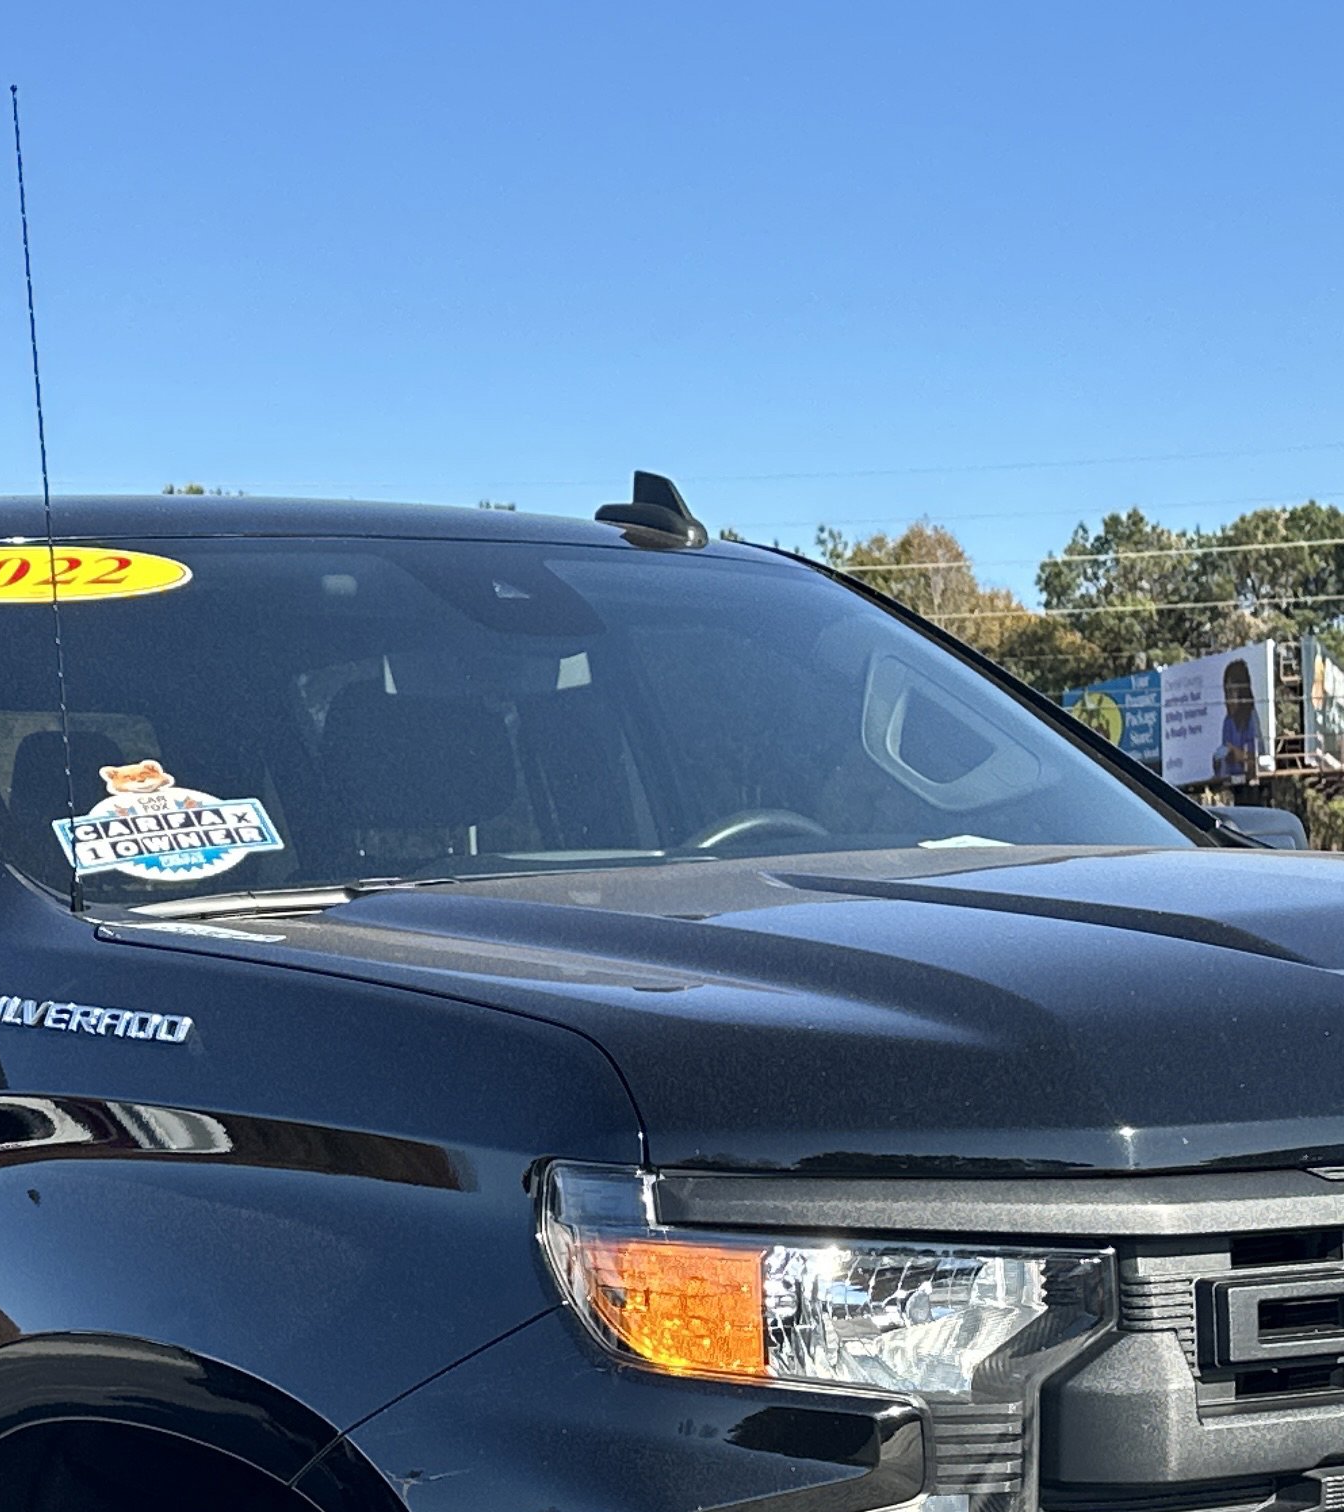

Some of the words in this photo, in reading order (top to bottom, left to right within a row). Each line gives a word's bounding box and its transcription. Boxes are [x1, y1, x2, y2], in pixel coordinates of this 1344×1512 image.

[73, 808, 253, 842] CARFAX
[85, 846, 103, 861] 1
[112, 826, 265, 858] OWNER
